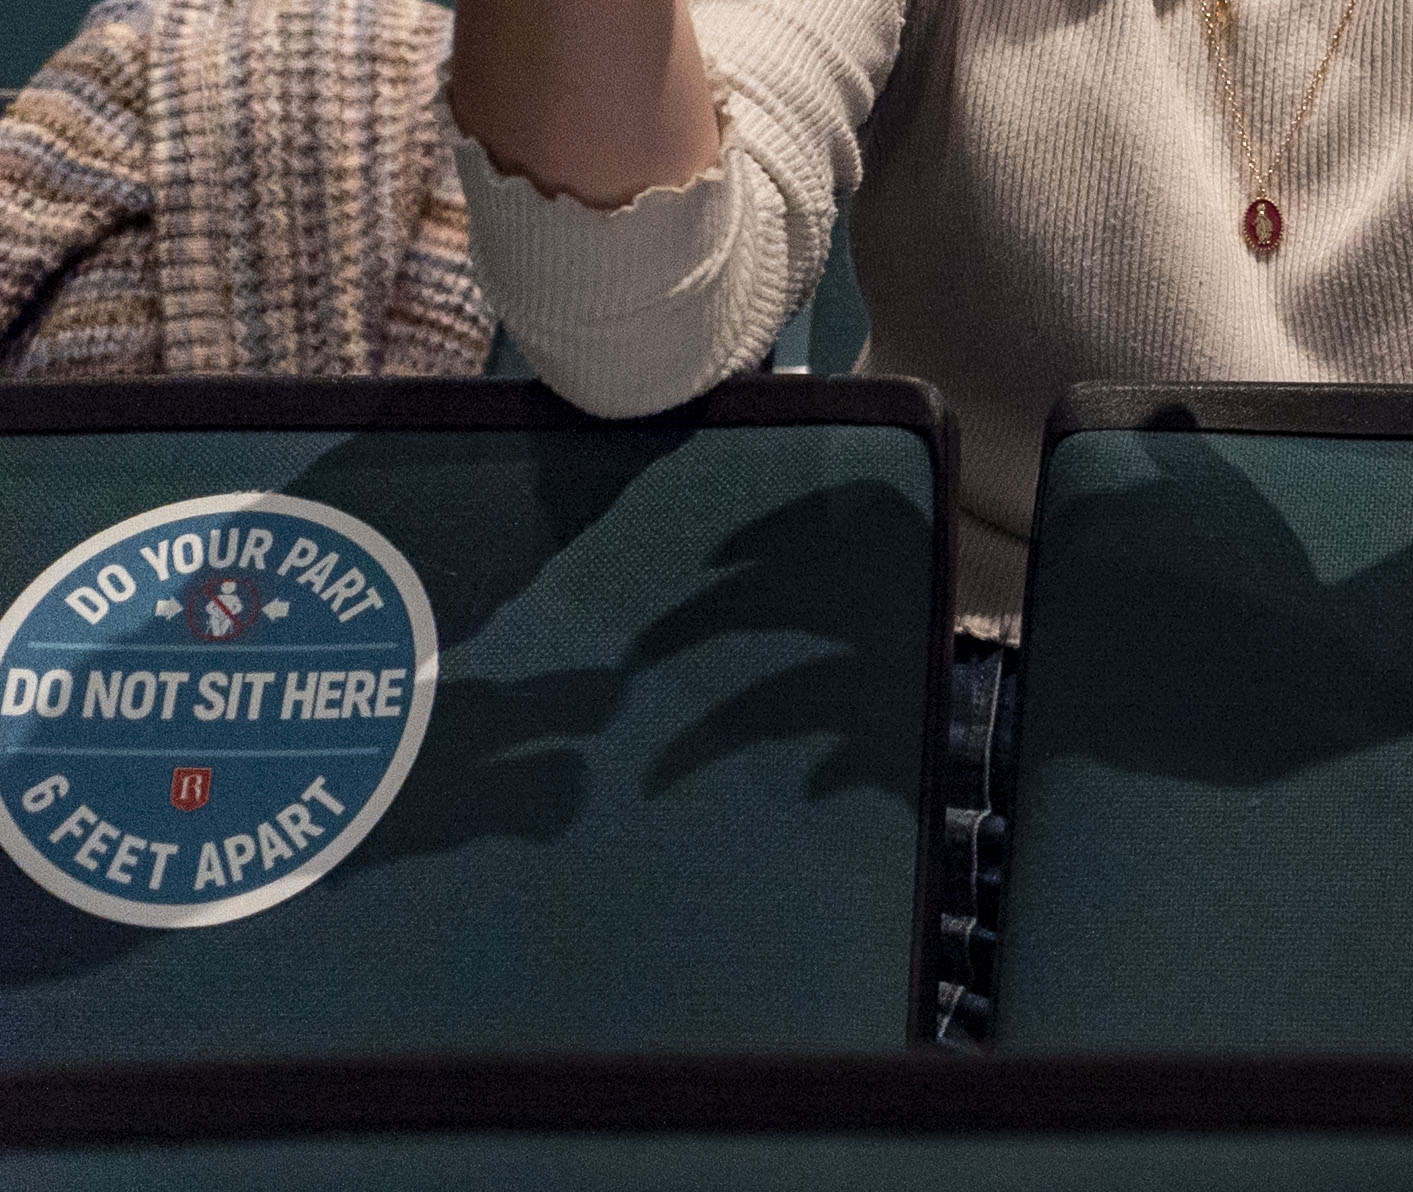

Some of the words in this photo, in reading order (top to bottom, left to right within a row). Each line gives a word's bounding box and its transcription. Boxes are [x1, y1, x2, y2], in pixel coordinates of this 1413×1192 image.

[65, 564, 136, 624] DO
[141, 529, 273, 582] YOUR
[278, 537, 384, 623] PART
[1, 668, 73, 718] DO
[81, 670, 189, 720] NOT
[193, 672, 275, 721] SIT
[280, 668, 407, 720] HERE
[20, 774, 71, 814] 6
[48, 804, 178, 890] FEET
[193, 775, 347, 890] APART
